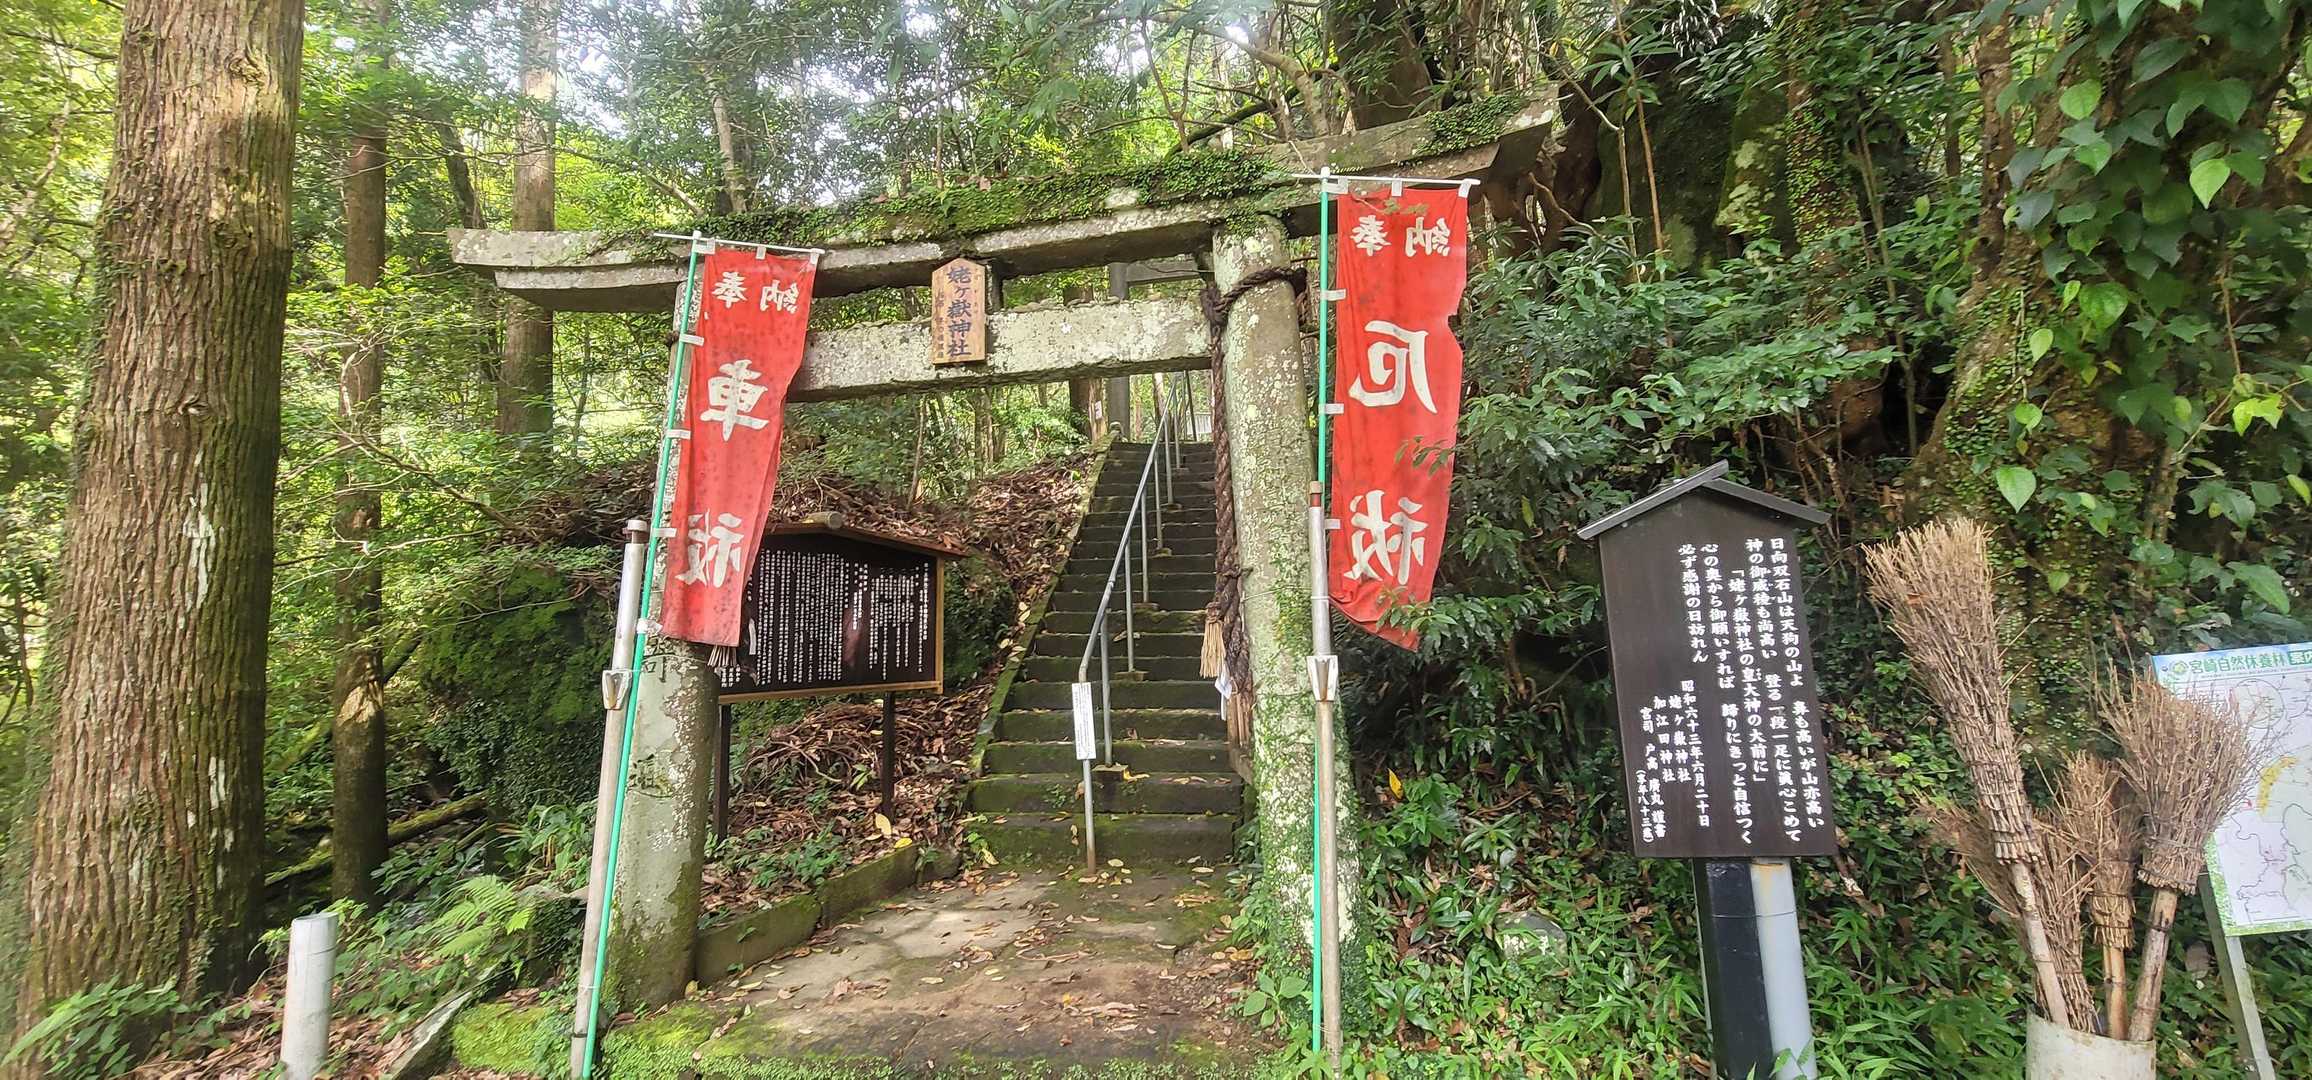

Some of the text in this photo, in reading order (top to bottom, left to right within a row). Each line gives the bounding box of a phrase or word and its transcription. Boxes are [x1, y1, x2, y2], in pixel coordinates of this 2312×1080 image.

[1678, 543, 1709, 663] 必ず感謝の日訪れん
[1701, 543, 1735, 689] 心の奥から御願いすれば
[1770, 537, 1804, 687] 日向双石山は天狗の山よ
[1640, 706, 1654, 733] 宮司
[1653, 695, 1676, 783] 加江田神社
[1681, 680, 1710, 827] 昭和六十三年六月二十日
